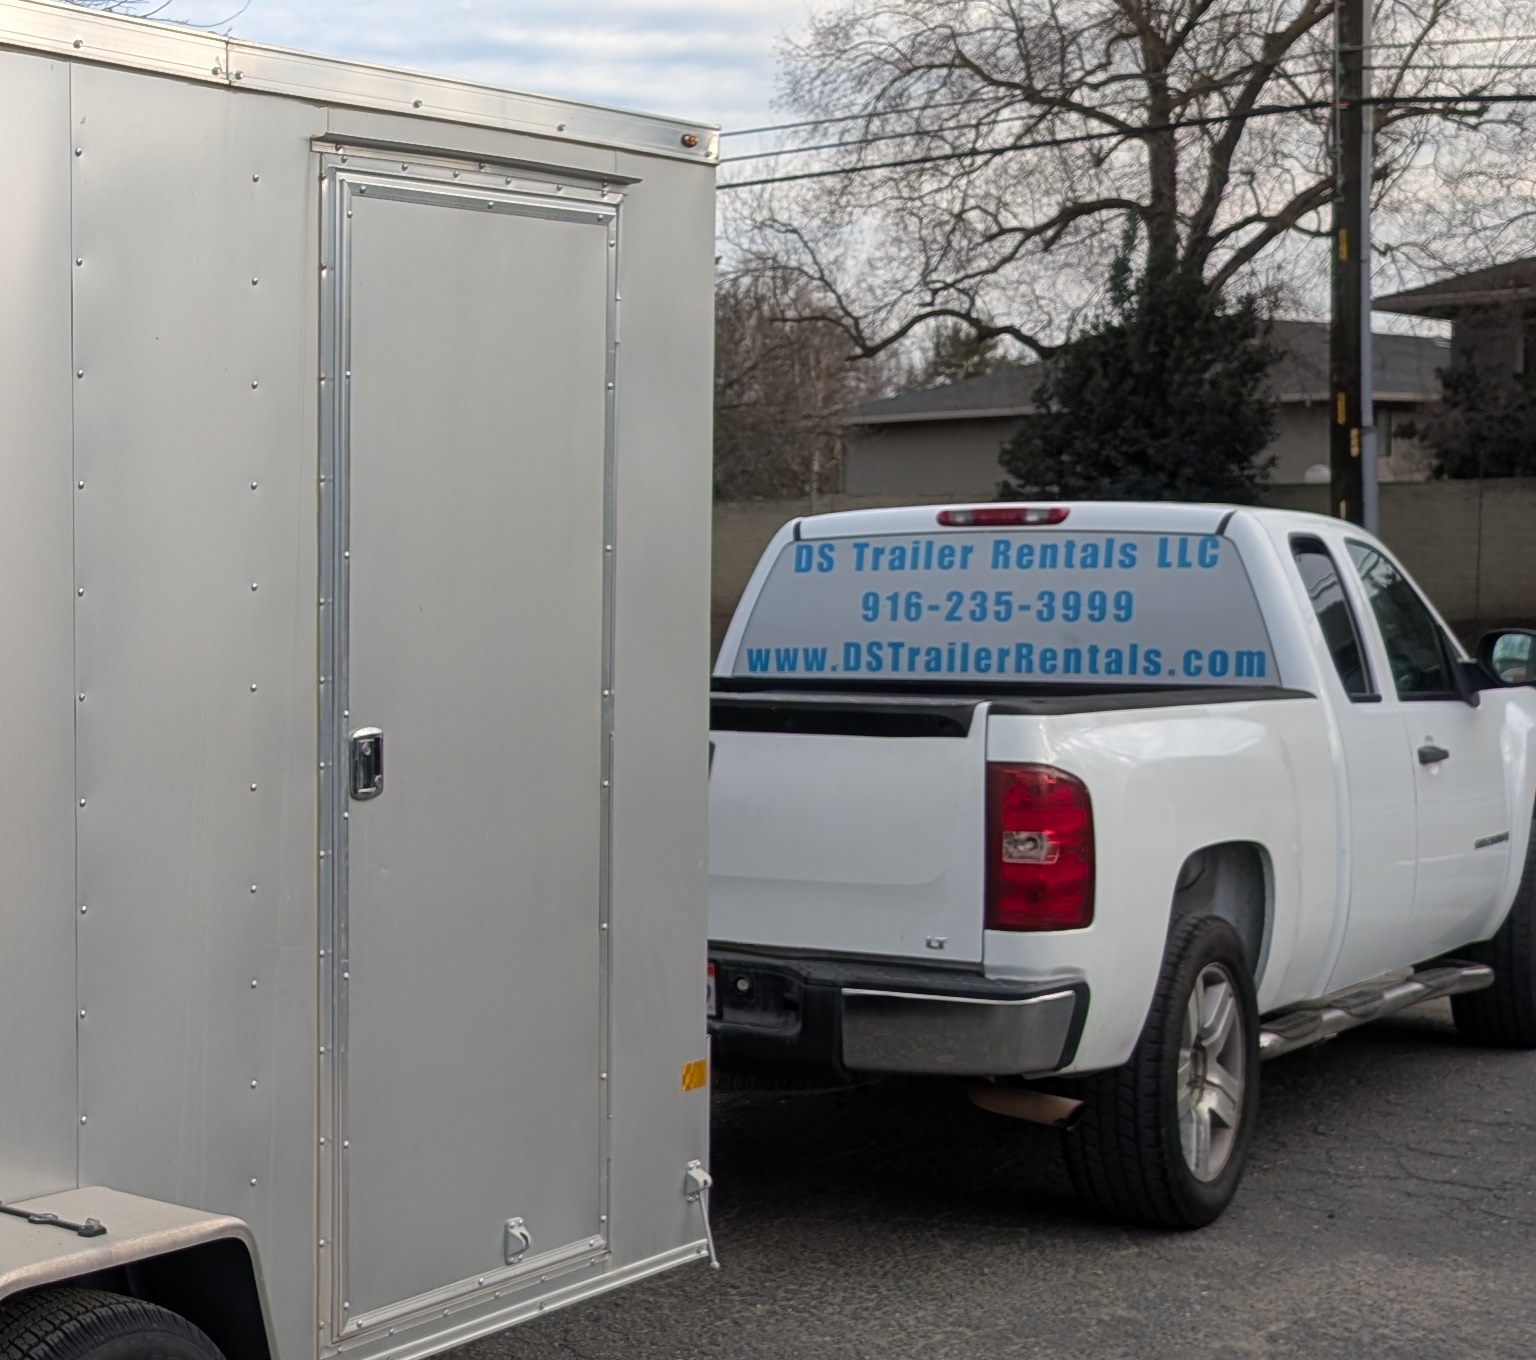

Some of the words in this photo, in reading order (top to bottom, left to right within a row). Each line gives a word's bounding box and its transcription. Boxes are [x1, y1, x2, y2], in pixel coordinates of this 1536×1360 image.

[794, 542, 835, 574] DS
[853, 539, 974, 572] Trailer
[991, 538, 1138, 570] Rentals
[1157, 535, 1221, 569] LLC
[861, 589, 1134, 623] 916-235-3999
[746, 641, 1266, 678] www.DSTrailerRentals.com
[925, 935, 949, 951] LT
